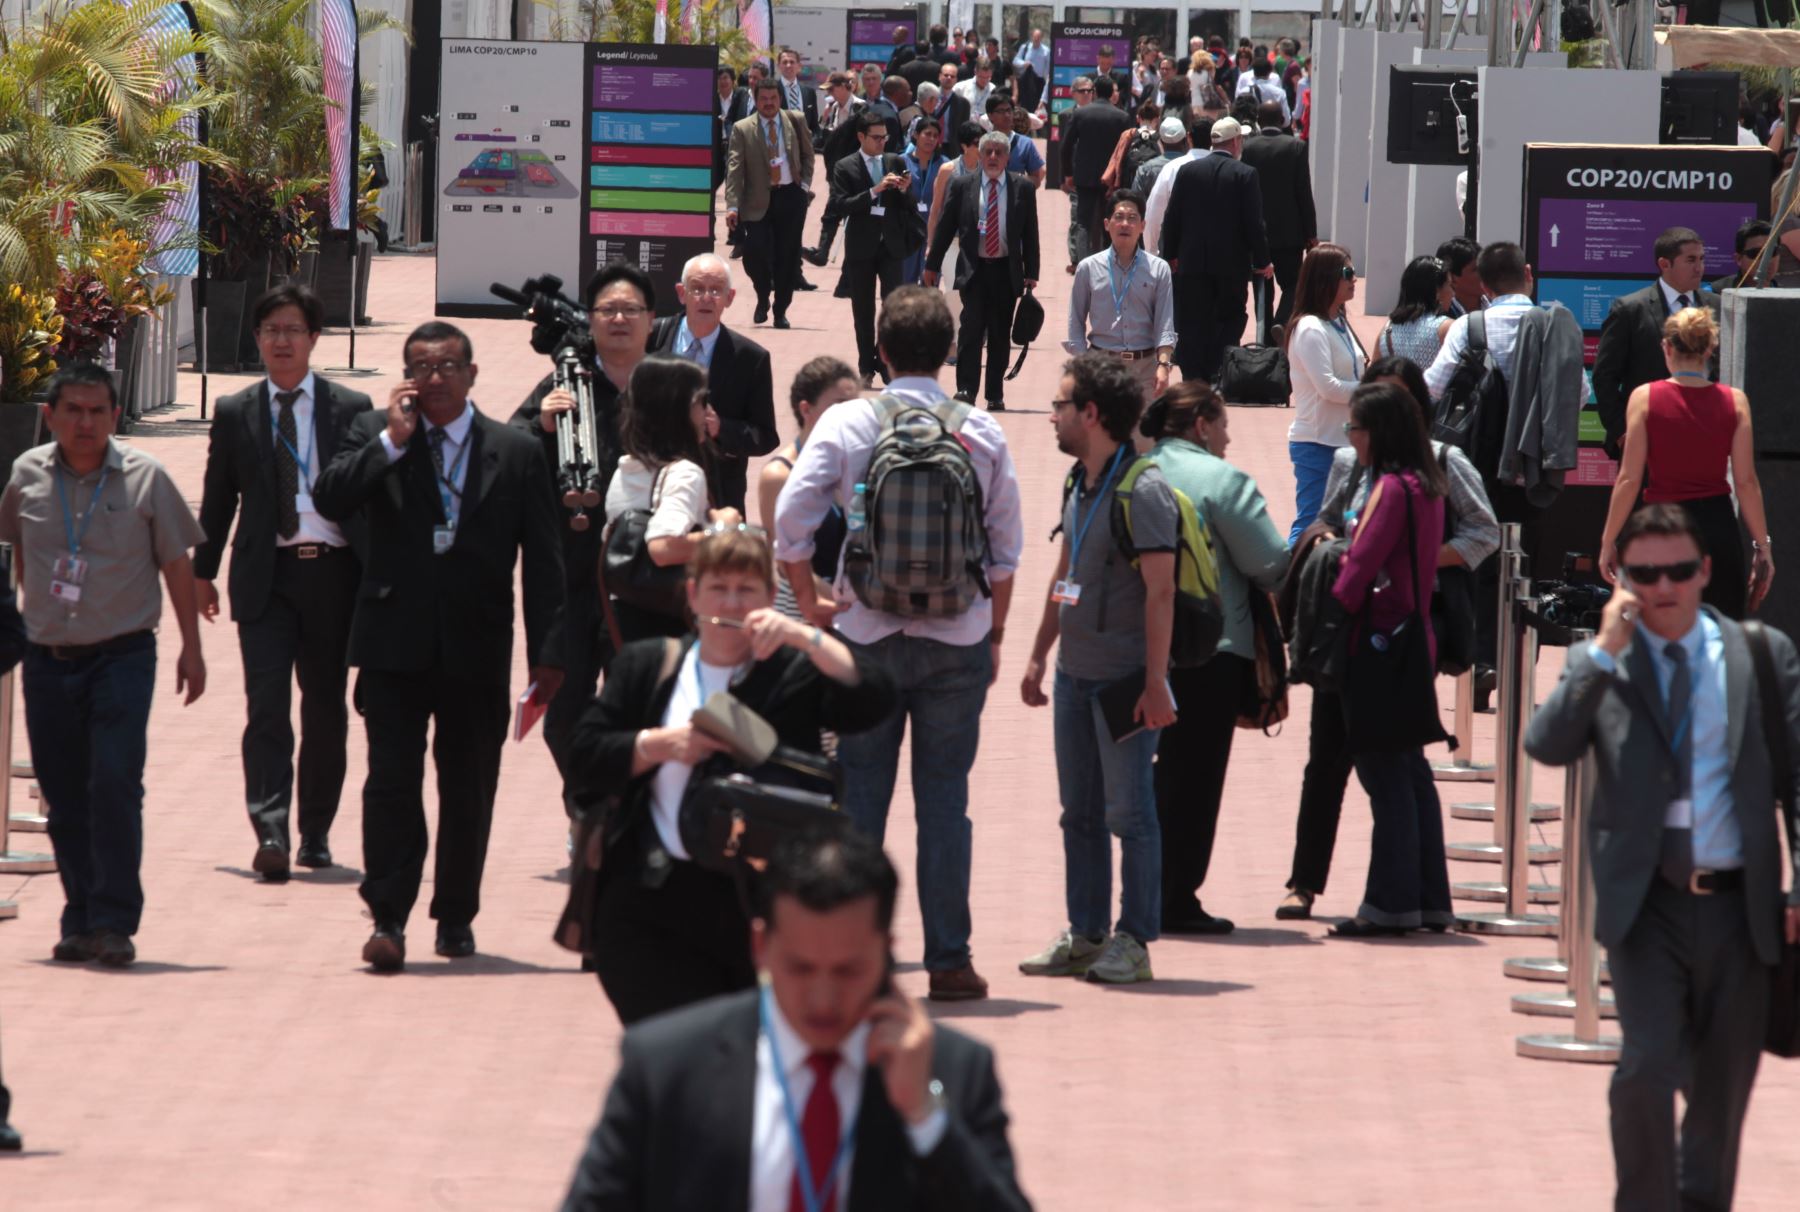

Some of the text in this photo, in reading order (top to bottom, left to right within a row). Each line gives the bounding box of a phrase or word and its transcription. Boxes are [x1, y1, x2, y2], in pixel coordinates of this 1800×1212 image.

[1064, 27, 1122, 36] COP20/CMP10
[449, 45, 537, 56] LIMA COP20/CMP10
[597, 51, 658, 62] Legend/ Leyenda
[1566, 168, 1733, 190] COP20/CMP10
